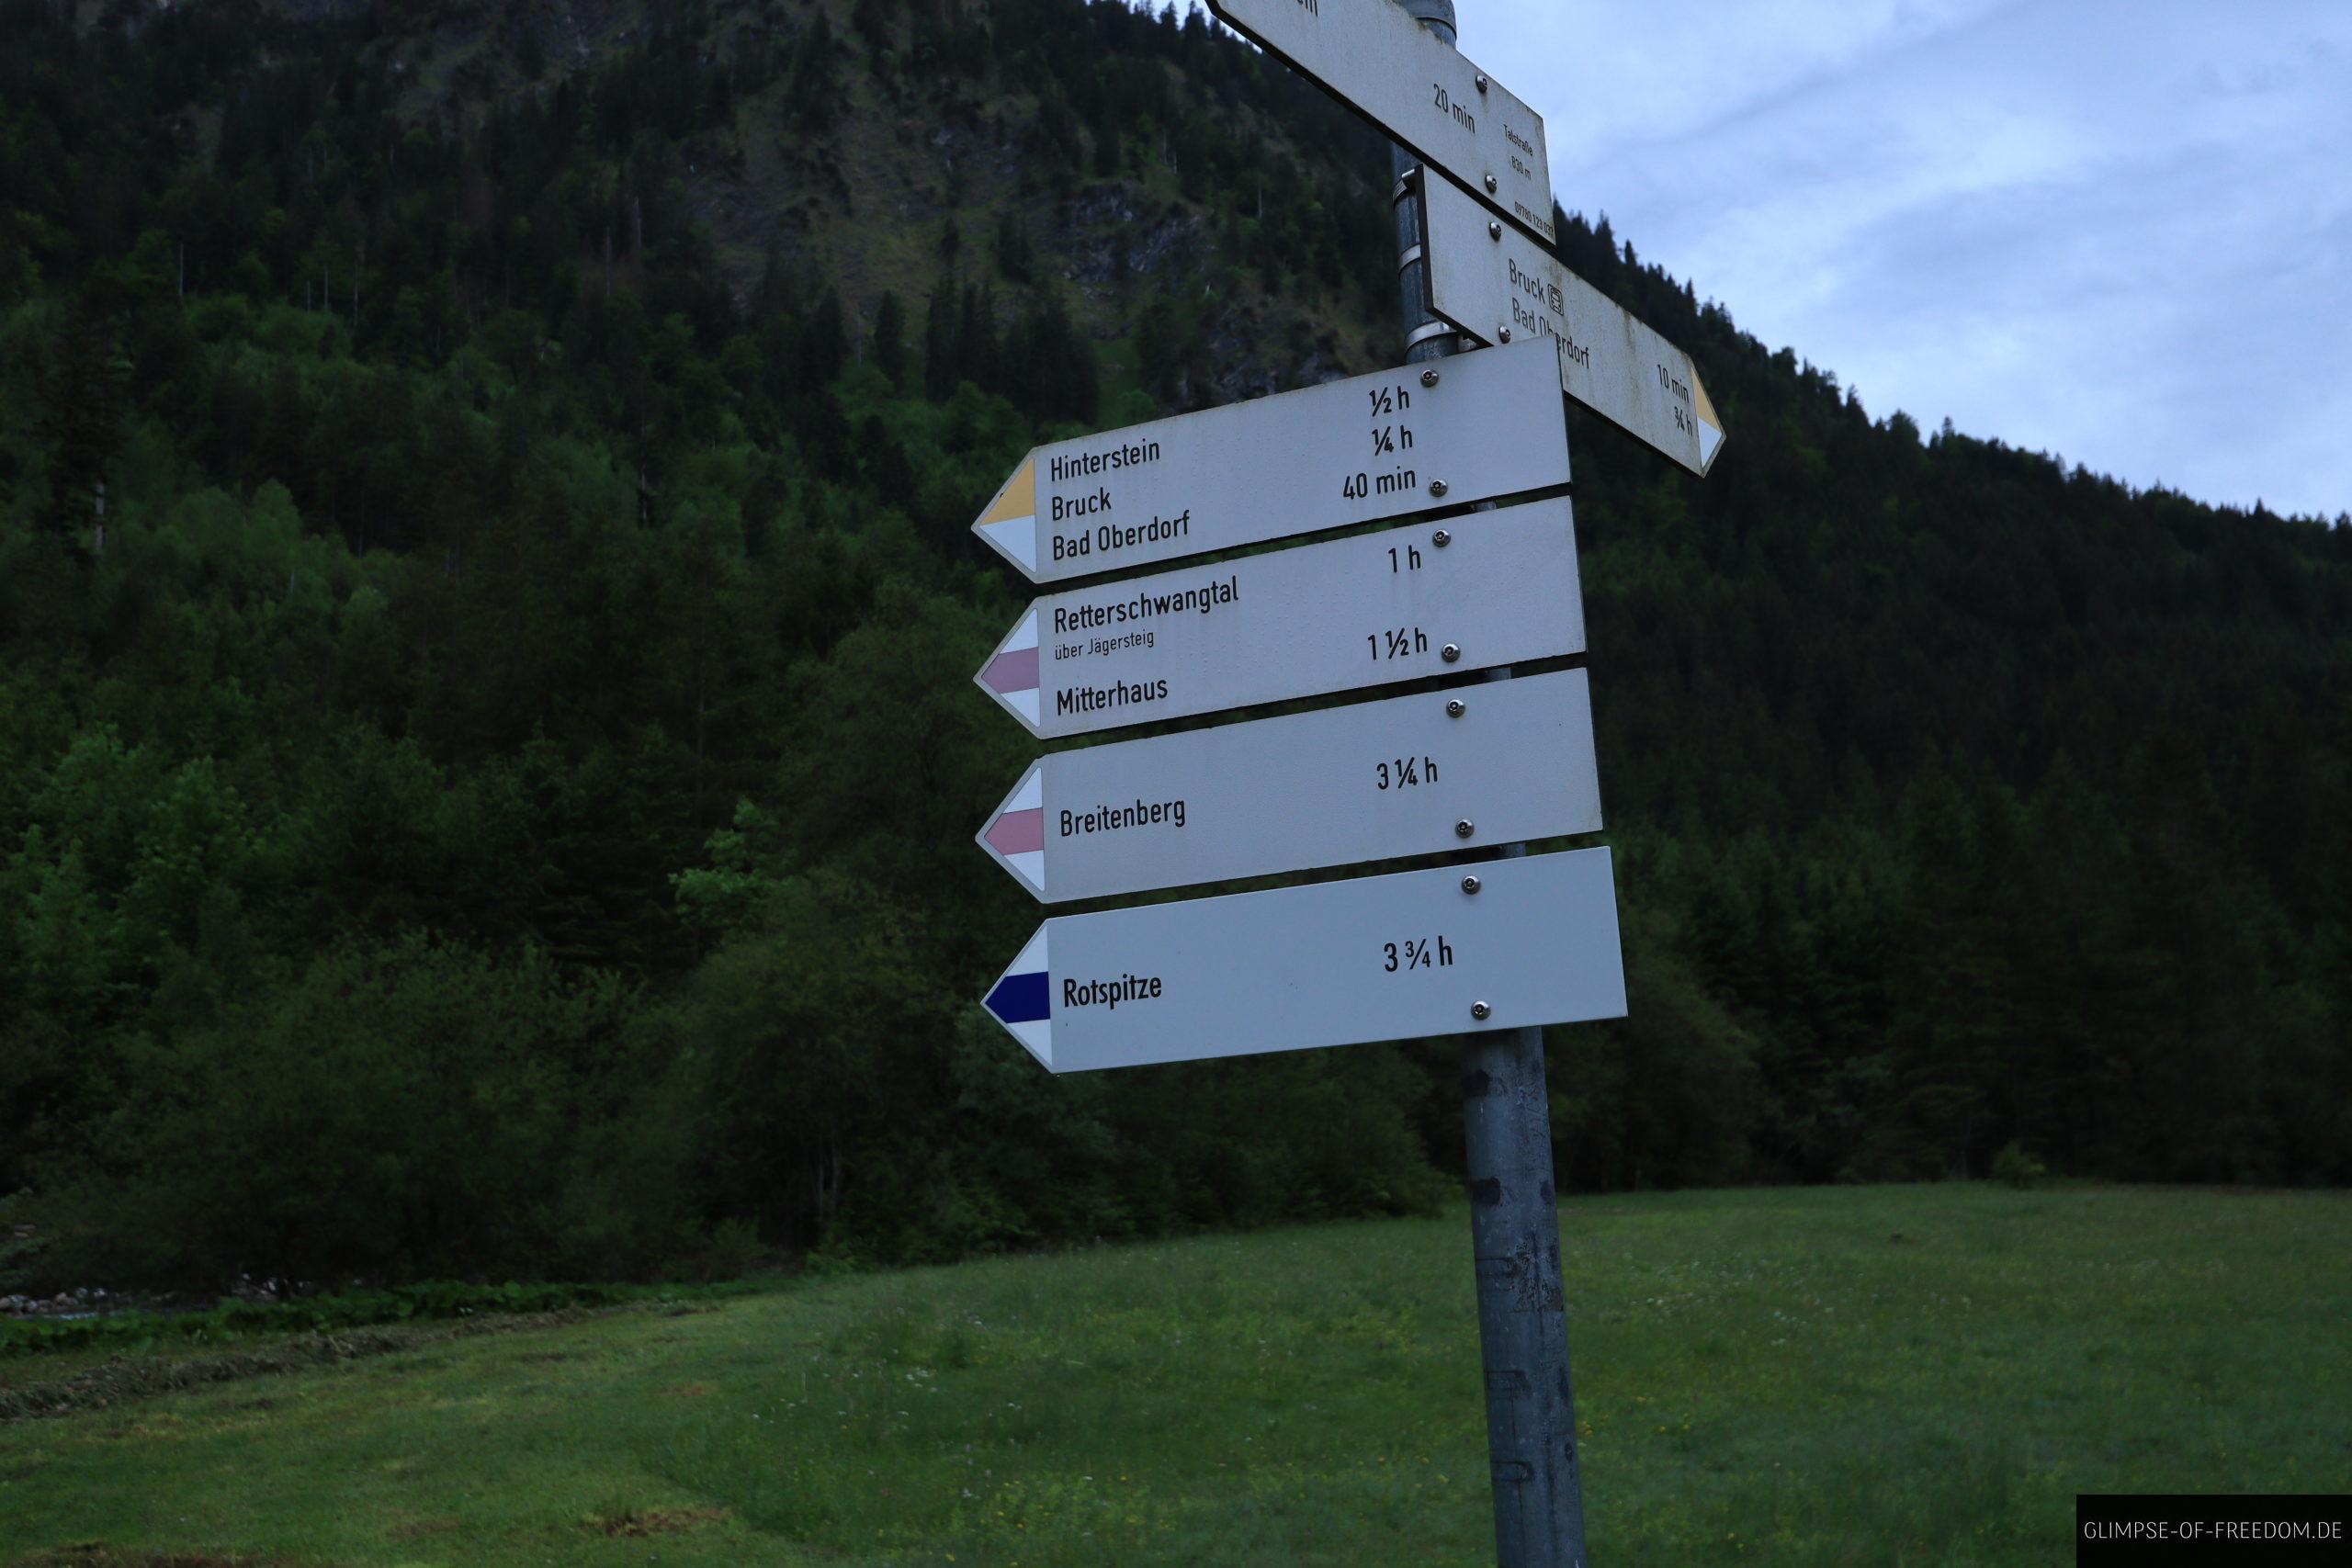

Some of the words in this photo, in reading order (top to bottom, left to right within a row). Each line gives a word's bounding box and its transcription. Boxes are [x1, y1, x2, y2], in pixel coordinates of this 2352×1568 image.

[1433, 84, 1449, 113] 20
[1453, 103, 1476, 134] min
[1503, 123, 1533, 156] Talstraße
[1510, 258, 1545, 305] Bruck
[1512, 298, 1536, 334] Bad
[1396, 385, 1410, 410] h
[1657, 364, 1669, 389] 10
[1671, 378, 1690, 404] min
[1400, 424, 1413, 449] h
[1686, 413, 1693, 437] h
[1050, 438, 1160, 482] Hinterstein
[1342, 472, 1368, 500] 40
[1376, 466, 1416, 494] min
[1051, 487, 1112, 521] Bruck
[1053, 529, 1091, 561] Bad
[1098, 510, 1191, 552] Oberdorf
[1387, 547, 1397, 573] 1
[1408, 544, 1421, 570] h
[1054, 575, 1239, 634] Retterschwangtal
[1055, 643, 1084, 660] über
[1088, 629, 1155, 656] Jägersteig
[1414, 626, 1428, 653] h
[1057, 679, 1169, 716] Mitterhaus
[1424, 756, 1438, 783] h
[1060, 799, 1186, 837] Breitenberg
[1384, 942, 1398, 972] 3
[1438, 935, 1453, 966] h
[1063, 973, 1162, 1010] Rotspitze
